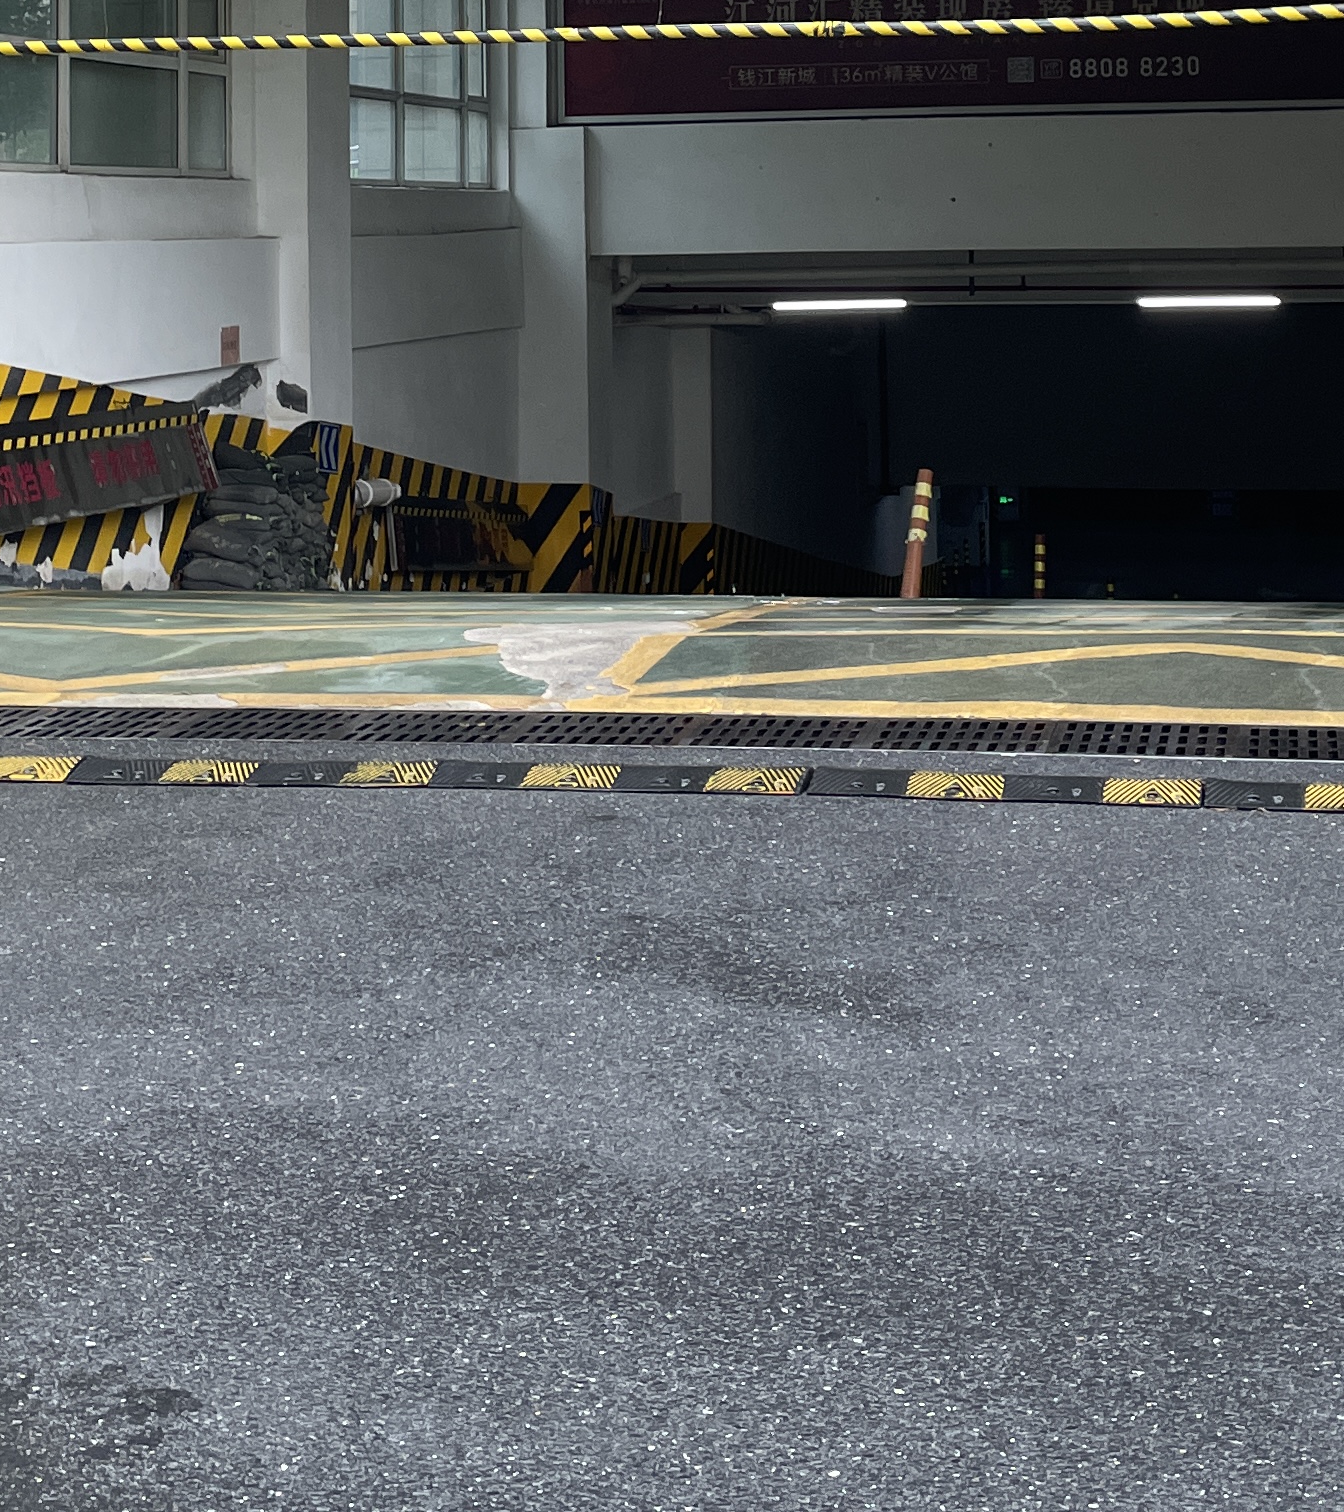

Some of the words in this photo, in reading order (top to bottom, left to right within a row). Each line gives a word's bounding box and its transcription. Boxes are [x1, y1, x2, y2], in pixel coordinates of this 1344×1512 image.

[736, 66, 818, 88] 钱江新城
[1068, 57, 1129, 79] 8808
[1139, 55, 1201, 77] 8230
